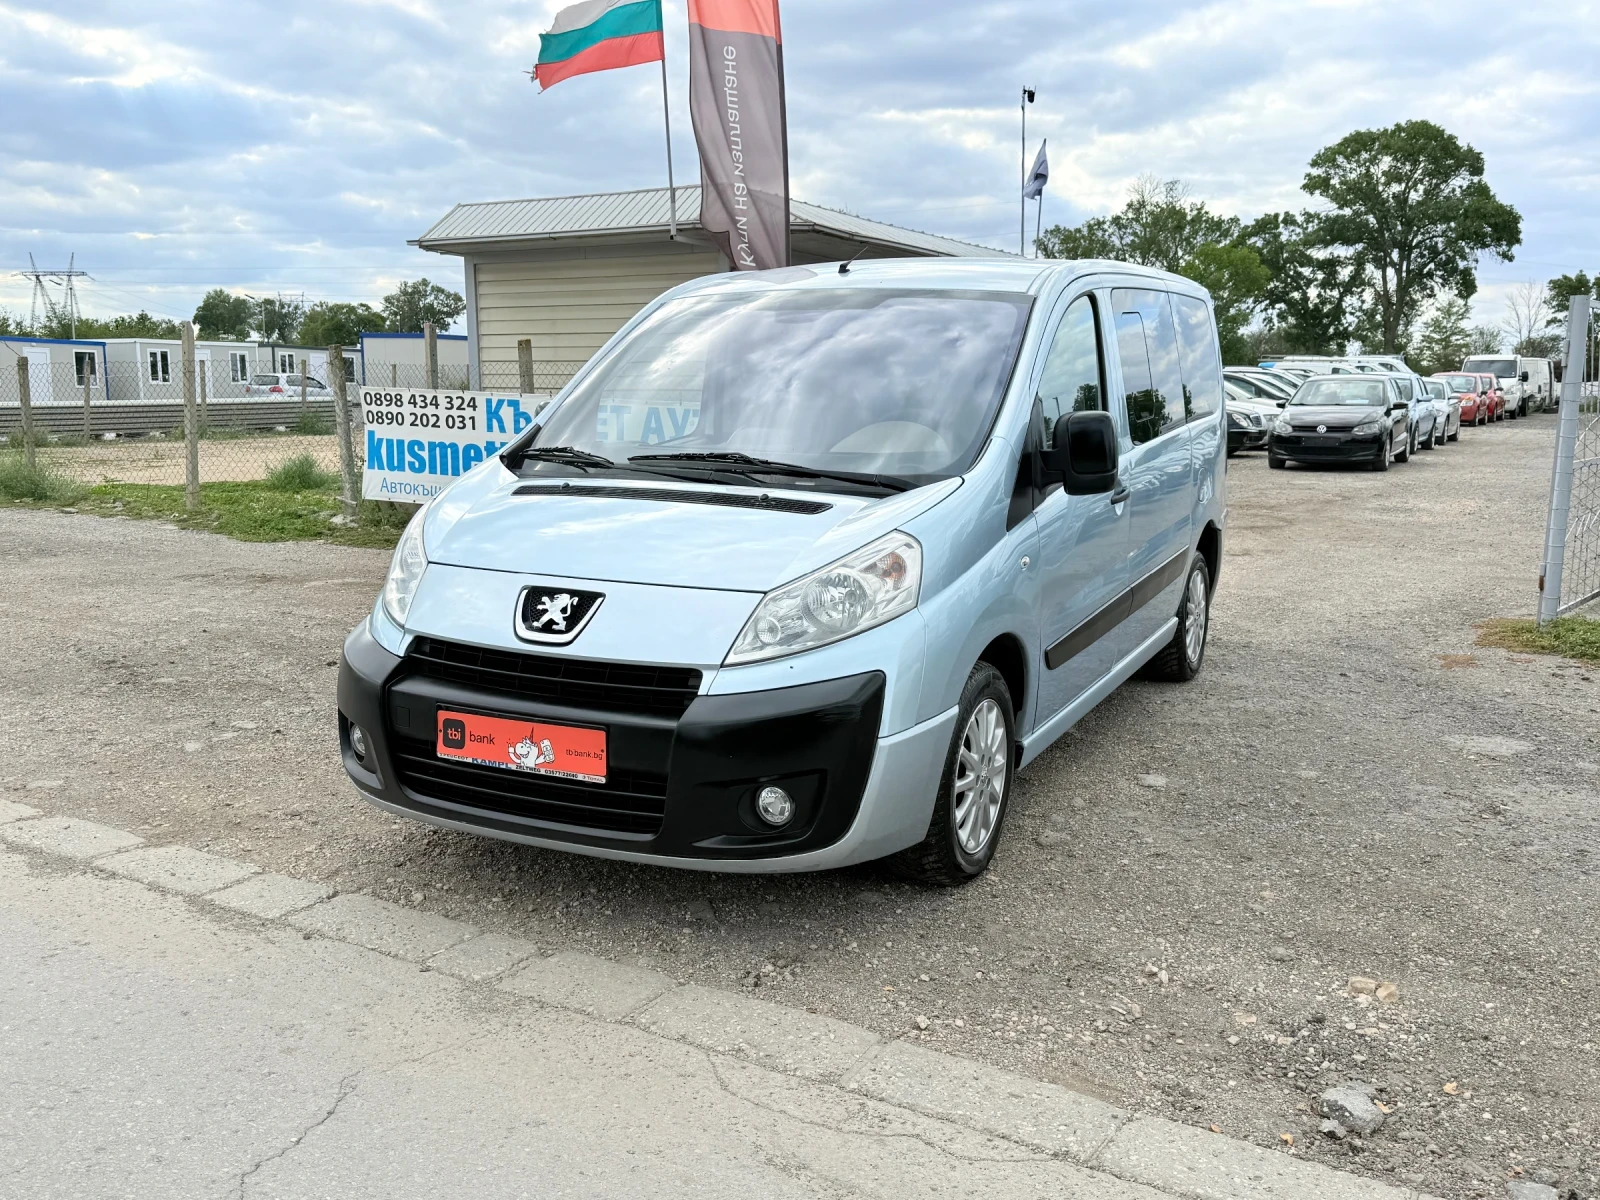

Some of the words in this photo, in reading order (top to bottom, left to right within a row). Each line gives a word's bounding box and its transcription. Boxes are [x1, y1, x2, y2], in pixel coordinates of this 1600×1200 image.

[363, 391, 403, 408] 0898
[408, 394, 440, 410] 434
[444, 395, 478, 411] 324
[366, 410, 405, 426] 0890
[410, 412, 440, 428] 202
[445, 414, 476, 431] 031
[447, 728, 461, 741] tbi
[469, 730, 495, 745] bank
